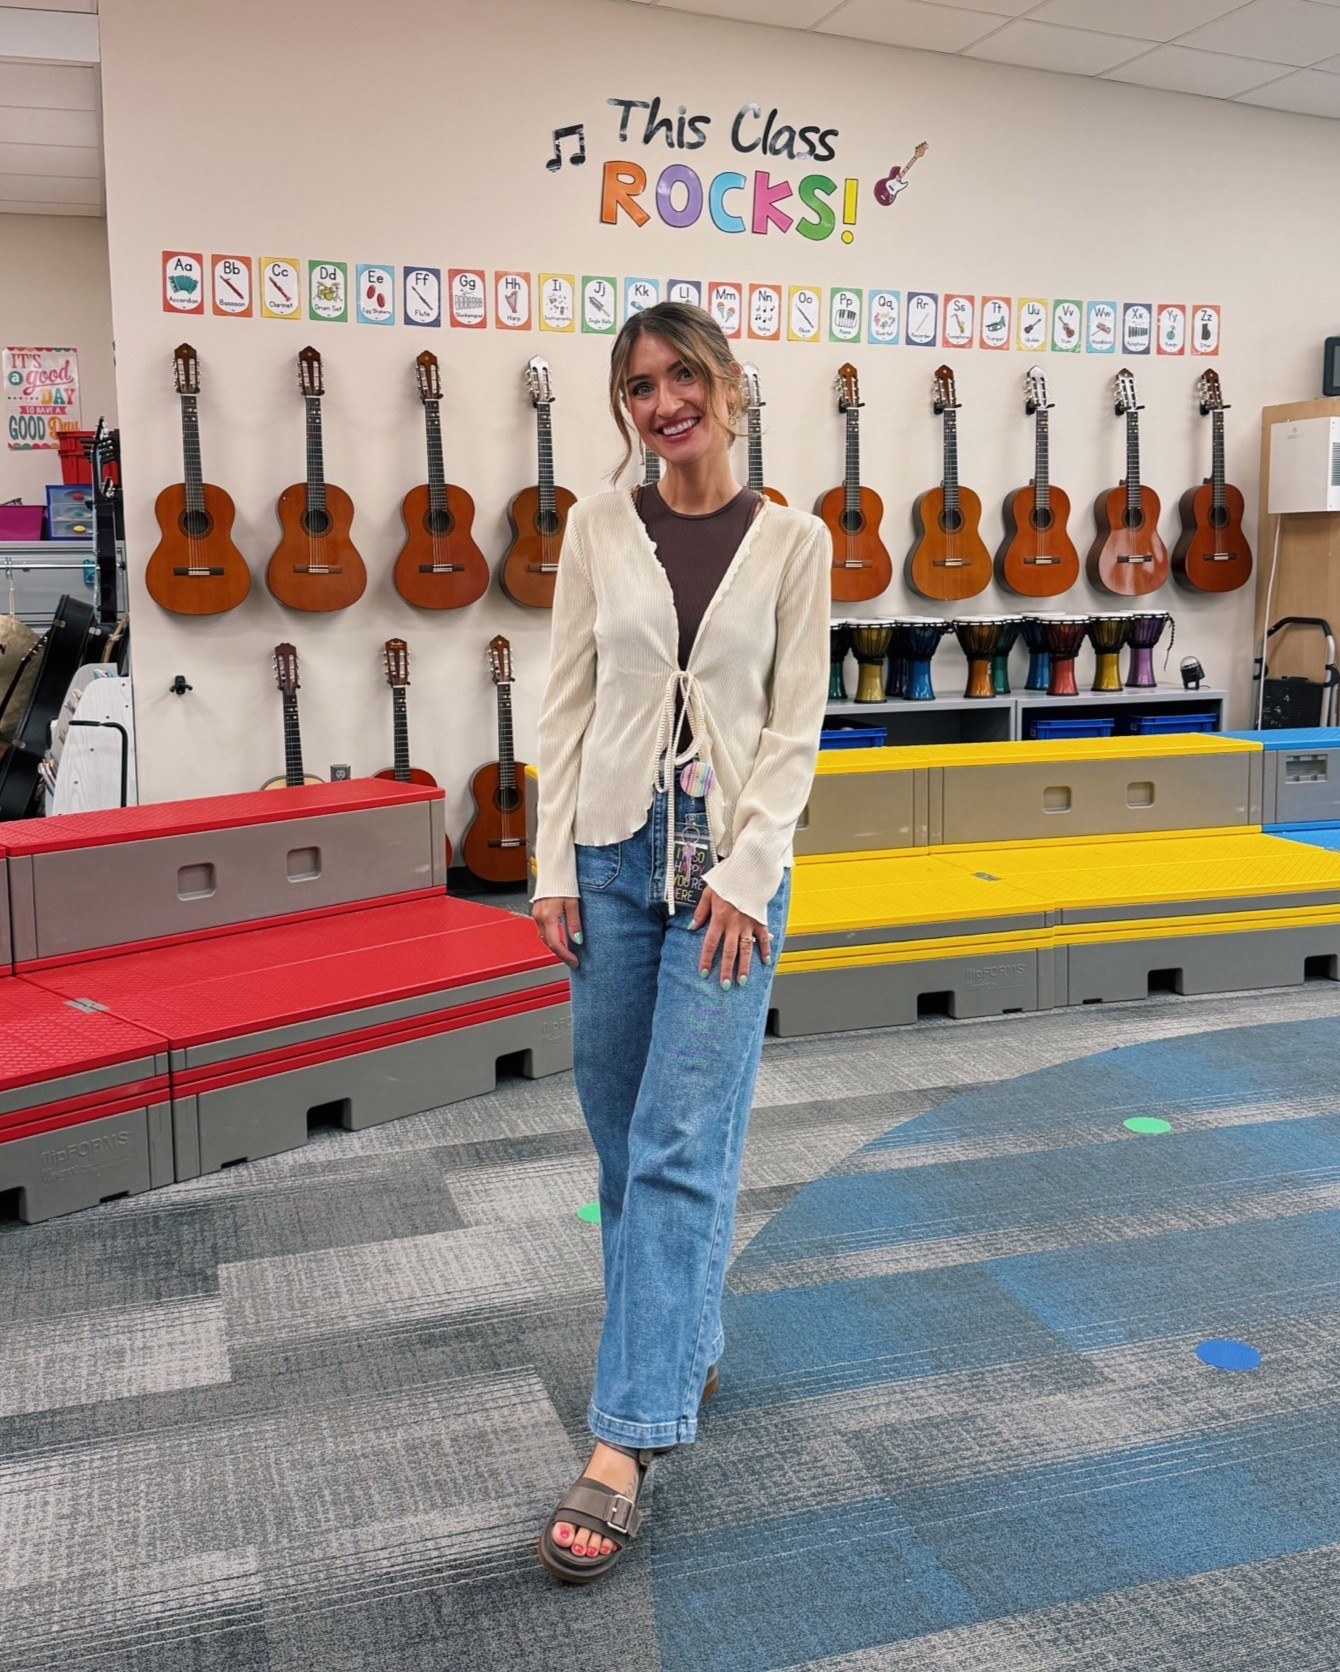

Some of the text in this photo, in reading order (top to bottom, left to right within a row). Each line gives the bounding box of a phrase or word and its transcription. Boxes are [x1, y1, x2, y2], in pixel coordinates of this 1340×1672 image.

[607, 96, 839, 161] This Class
[599, 160, 859, 245] ROCKS!
[174, 258, 193, 271] Aa
[223, 261, 240, 275] Bb
[271, 264, 289, 277] Cc
[320, 266, 337, 280] Dd
[368, 270, 384, 284] Ee
[415, 272, 430, 286] Ff
[459, 274, 476, 291] Gg
[505, 277, 521, 290] Hh
[552, 279, 561, 291] Ii
[594, 281, 606, 297] Jj
[635, 284, 649, 297] Kk
[679, 286, 689, 299] Ll
[716, 288, 736, 300] Mm
[758, 290, 773, 302] Nn
[798, 292, 813, 304] Oo
[840, 293, 853, 308] Pp
[878, 296, 894, 311] Qq
[916, 297, 930, 310] Rr
[314, 303, 331, 311] Drum
[953, 299, 966, 312] Ss
[991, 301, 1002, 314] Tt
[1027, 303, 1040, 315] Uu
[1062, 305, 1074, 317] Vv
[414, 309, 431, 317] Flute
[1094, 307, 1112, 318] Ww
[1131, 308, 1144, 320] Xx
[1166, 310, 1178, 323] Yy
[1200, 310, 1213, 322] Zz
[11, 353, 42, 369] IT'S
[11, 359, 74, 396] a good
[41, 388, 76, 405] DAY
[26, 406, 61, 414] TO HAVE A
[9, 415, 46, 440] GOOD
[675, 860, 705, 877] HAPY
[674, 874, 705, 890] YOURE
[675, 888, 695, 901] ERE
